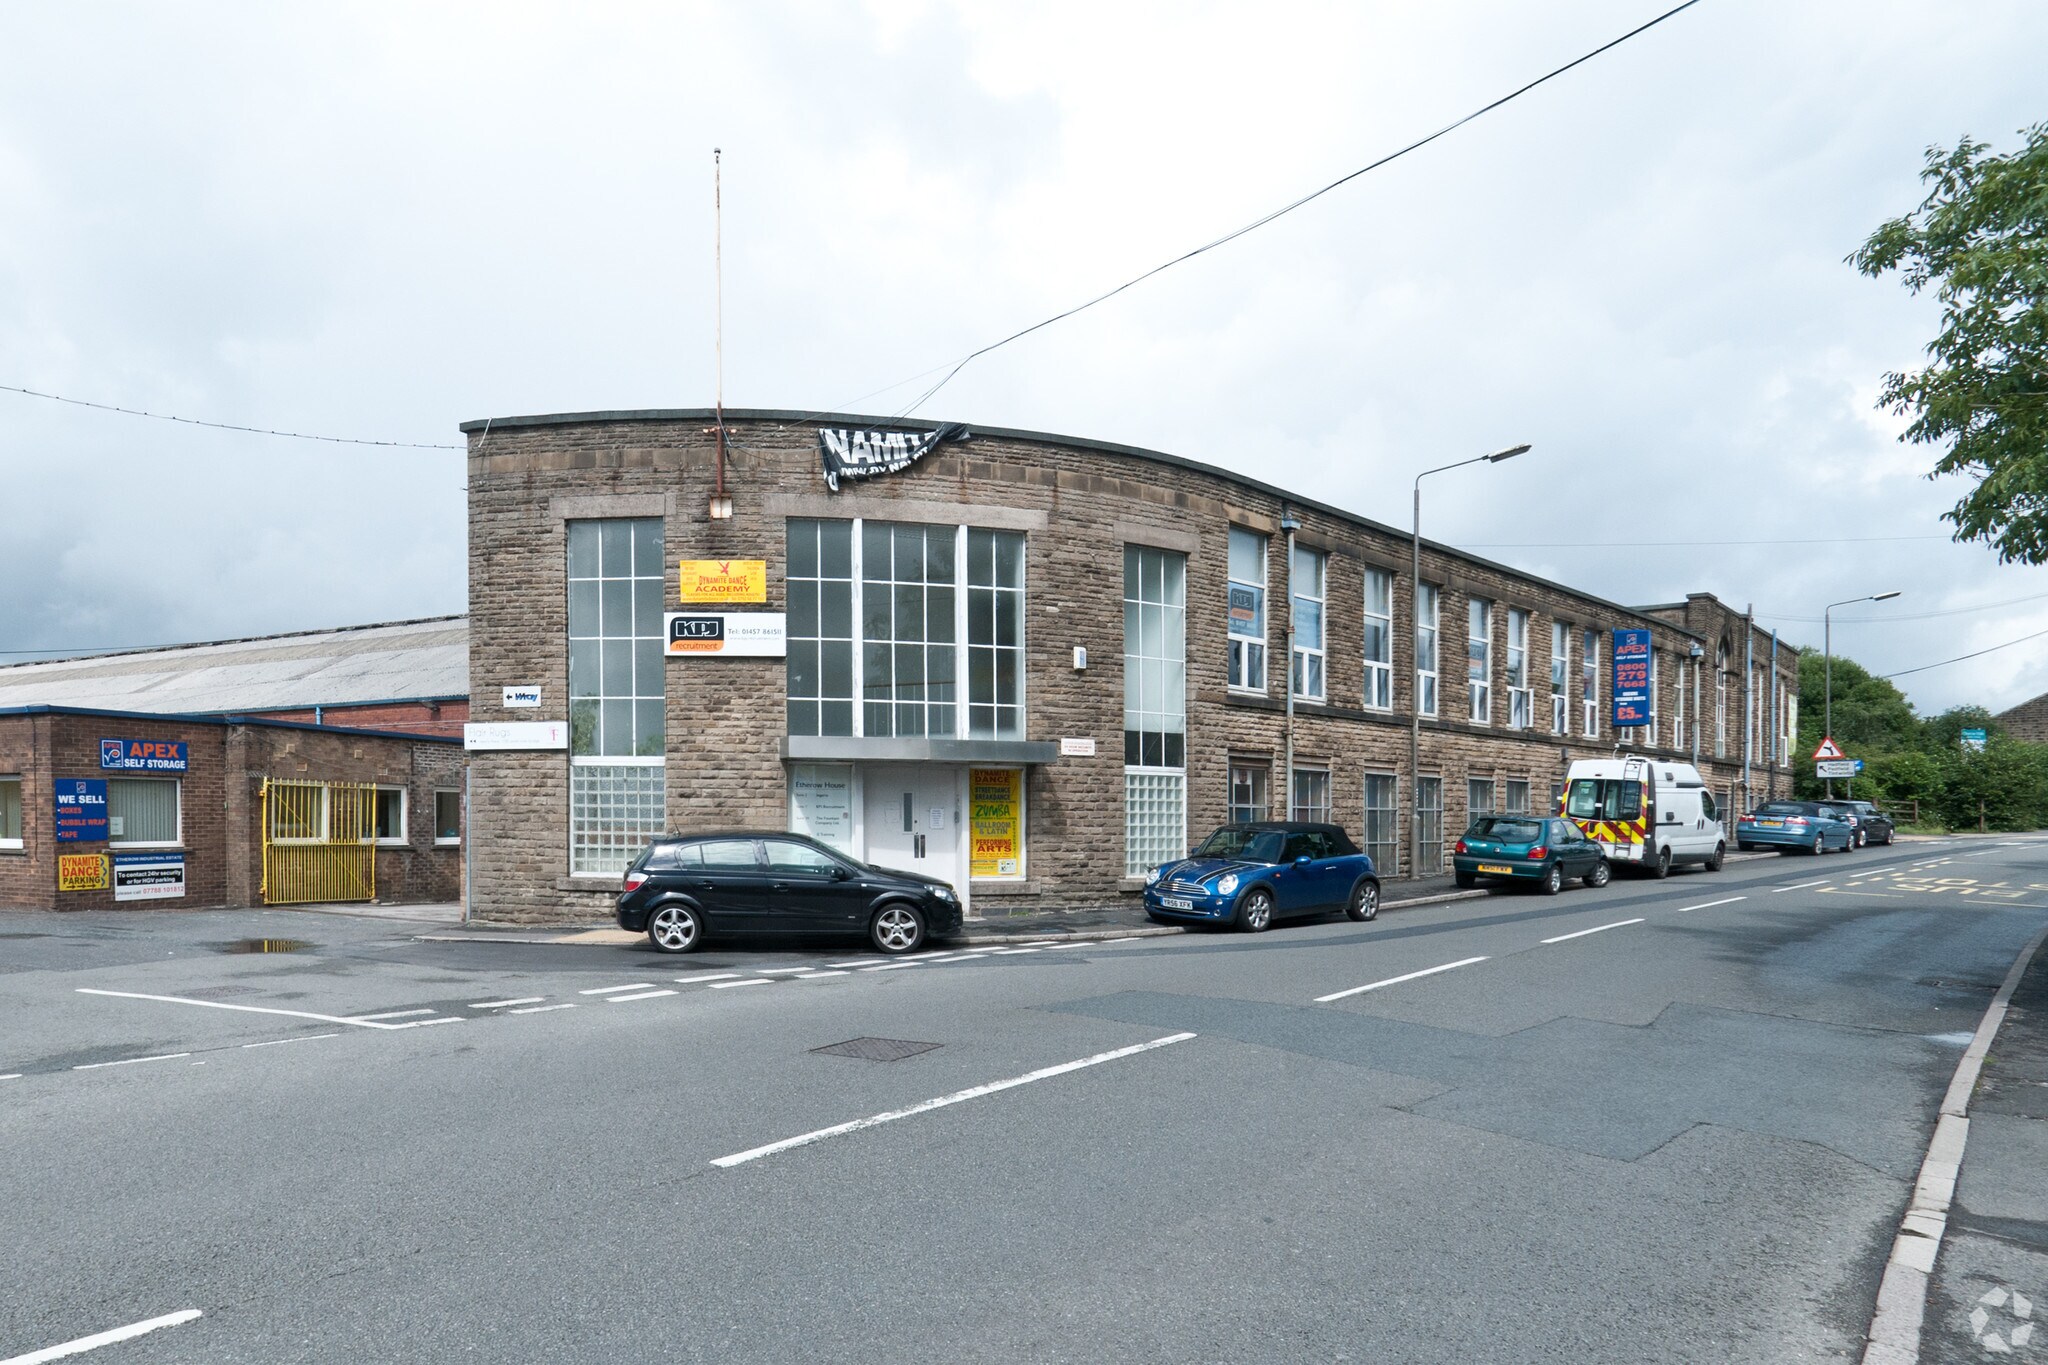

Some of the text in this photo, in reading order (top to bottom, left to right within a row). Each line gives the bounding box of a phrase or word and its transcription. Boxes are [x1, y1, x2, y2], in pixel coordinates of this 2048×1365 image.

[676, 642, 718, 650] recruitment
[1616, 644, 1647, 655] APEX
[1617, 671, 1647, 680] 279
[128, 742, 179, 758] APEX
[124, 759, 145, 768] SELF
[147, 760, 186, 769] STORAGE
[58, 795, 105, 804] WE SELL
[975, 804, 1010, 817] ZUMBA
[62, 856, 100, 867] DYNAMITE
[62, 867, 100, 877] DANCE
[63, 876, 101, 884] PARKING
